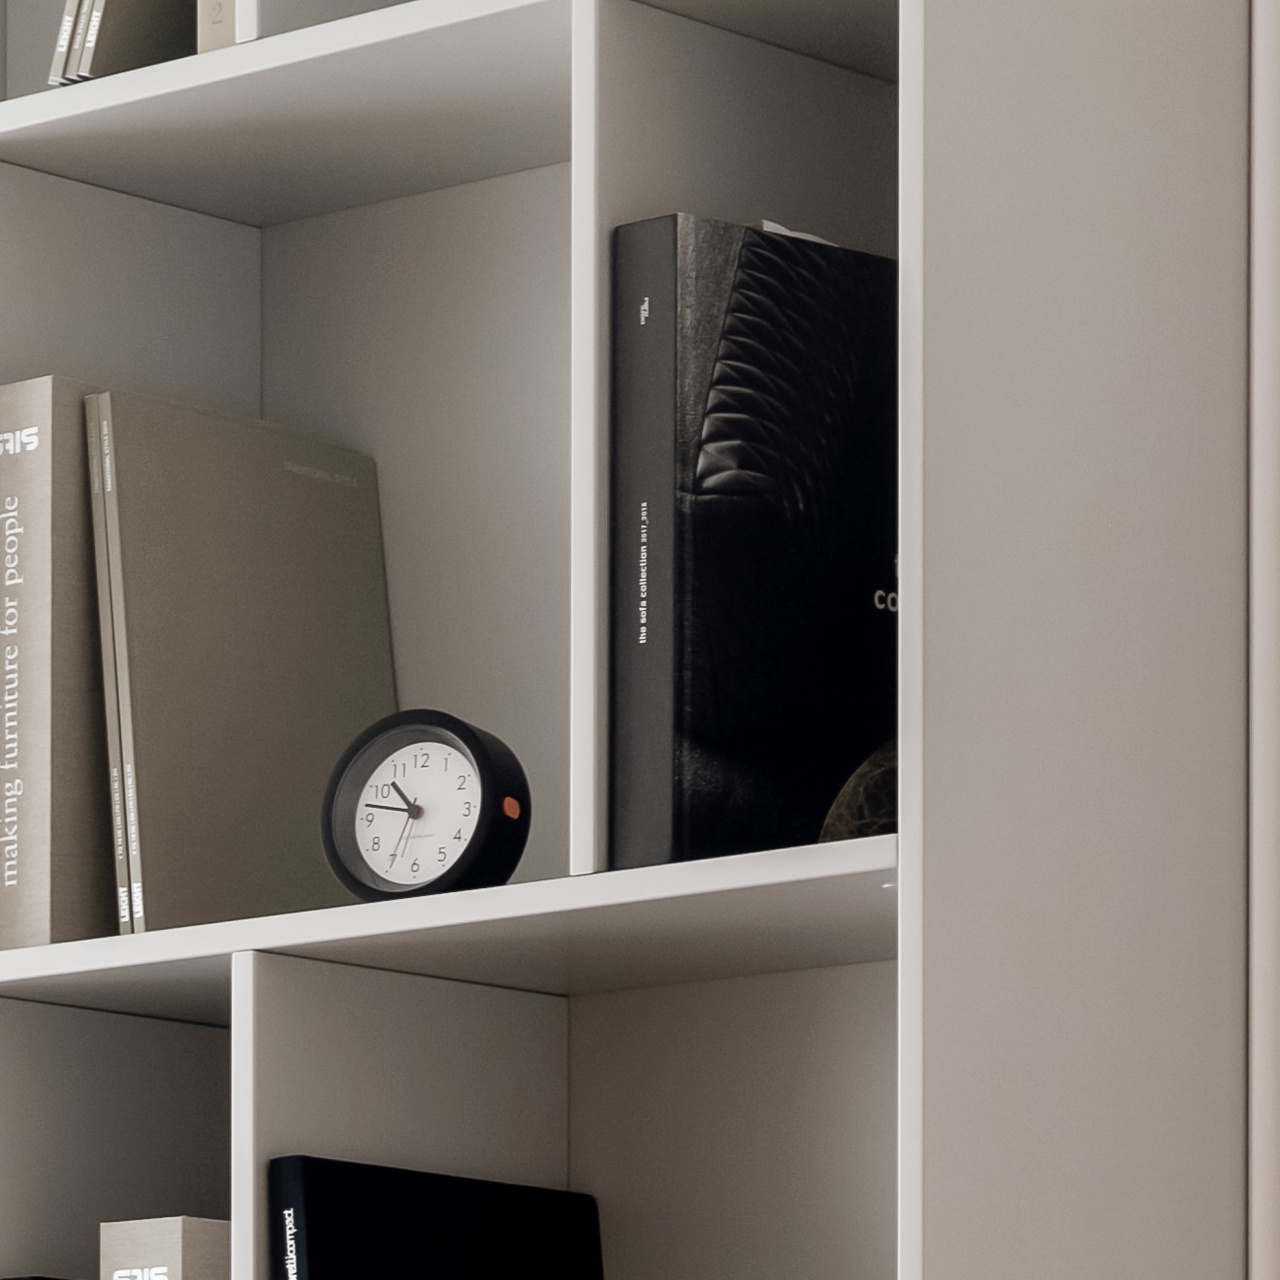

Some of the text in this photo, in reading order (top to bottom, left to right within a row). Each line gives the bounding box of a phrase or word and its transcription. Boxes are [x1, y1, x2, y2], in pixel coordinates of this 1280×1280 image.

[57, 15, 74, 53] LEICHT
[85, 9, 102, 48] LEICHT
[0, 496, 23, 586] people
[638, 546, 647, 598] collection
[638, 600, 647, 624] sofa
[413, 753, 430, 769] 12
[443, 757, 448, 772] 1
[392, 763, 406, 778] 11
[374, 783, 390, 799] 10
[457, 775, 466, 791] 2
[462, 801, 471, 817] 3
[365, 812, 375, 827] 9
[0, 778, 23, 887] making
[453, 828, 462, 842] 4
[371, 836, 380, 852] 8
[437, 846, 446, 862] 5
[410, 857, 420, 873] 6
[118, 887, 130, 923] LEICHT
[132, 882, 144, 919] LEICHT
